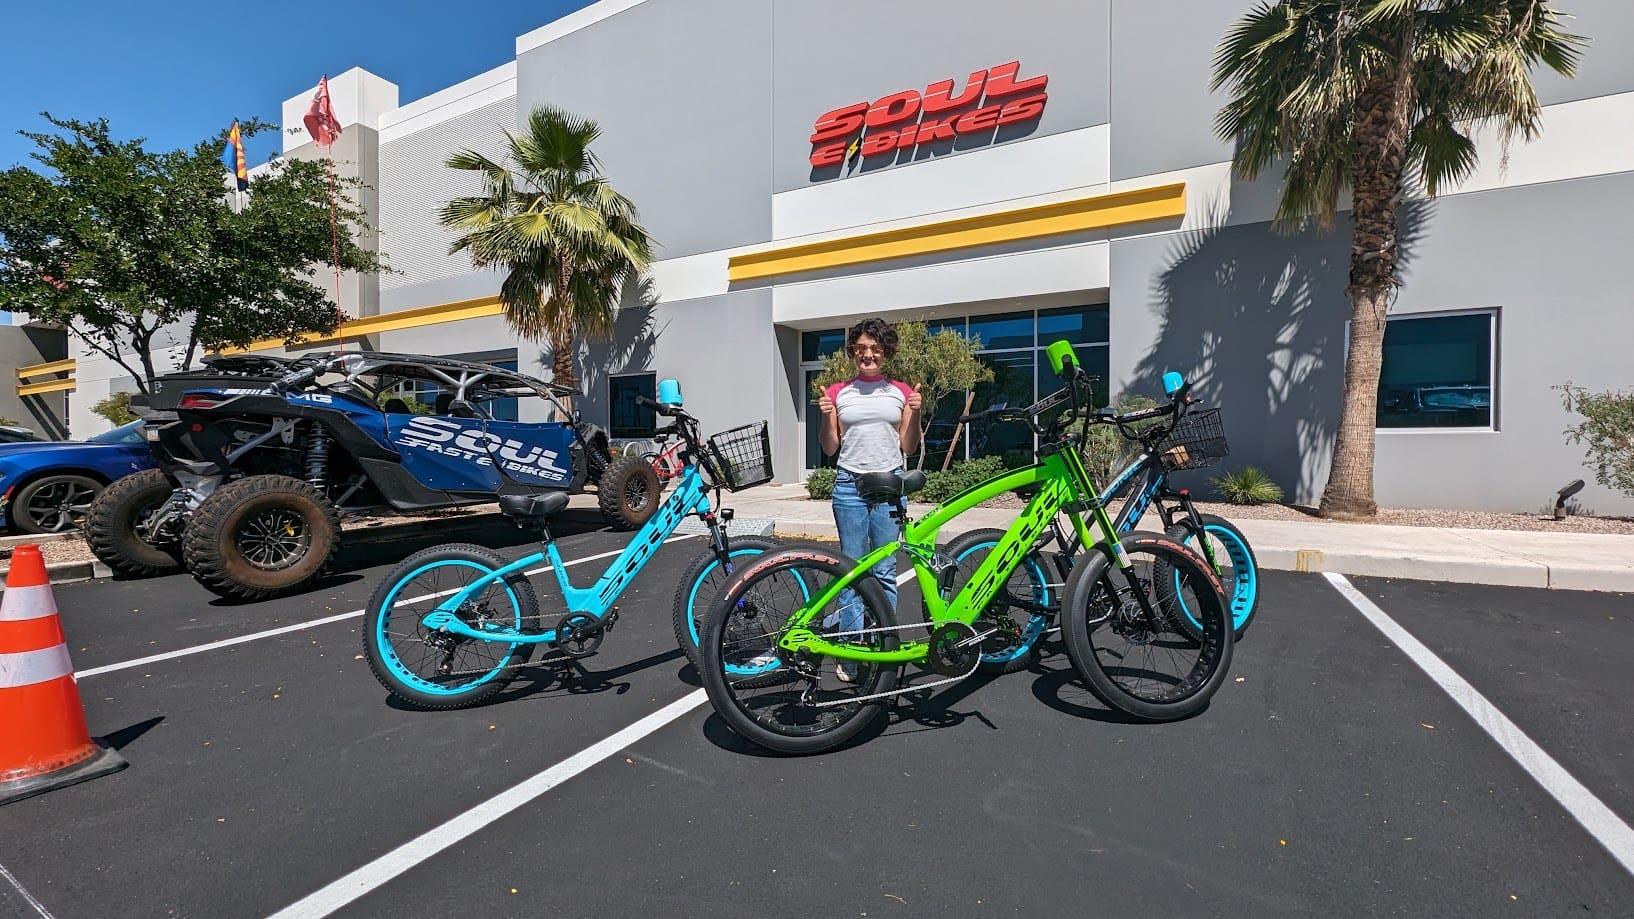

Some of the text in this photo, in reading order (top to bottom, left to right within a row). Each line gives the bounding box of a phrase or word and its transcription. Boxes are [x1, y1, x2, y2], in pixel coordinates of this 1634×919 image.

[809, 60, 1048, 144] SOUL
[809, 92, 1048, 168] E BIKES
[395, 436, 479, 461] FAST
[507, 462, 565, 482] BIKES
[400, 416, 567, 475] SOUL
[600, 489, 697, 607] SOUL
[970, 485, 1069, 611] SOUL
